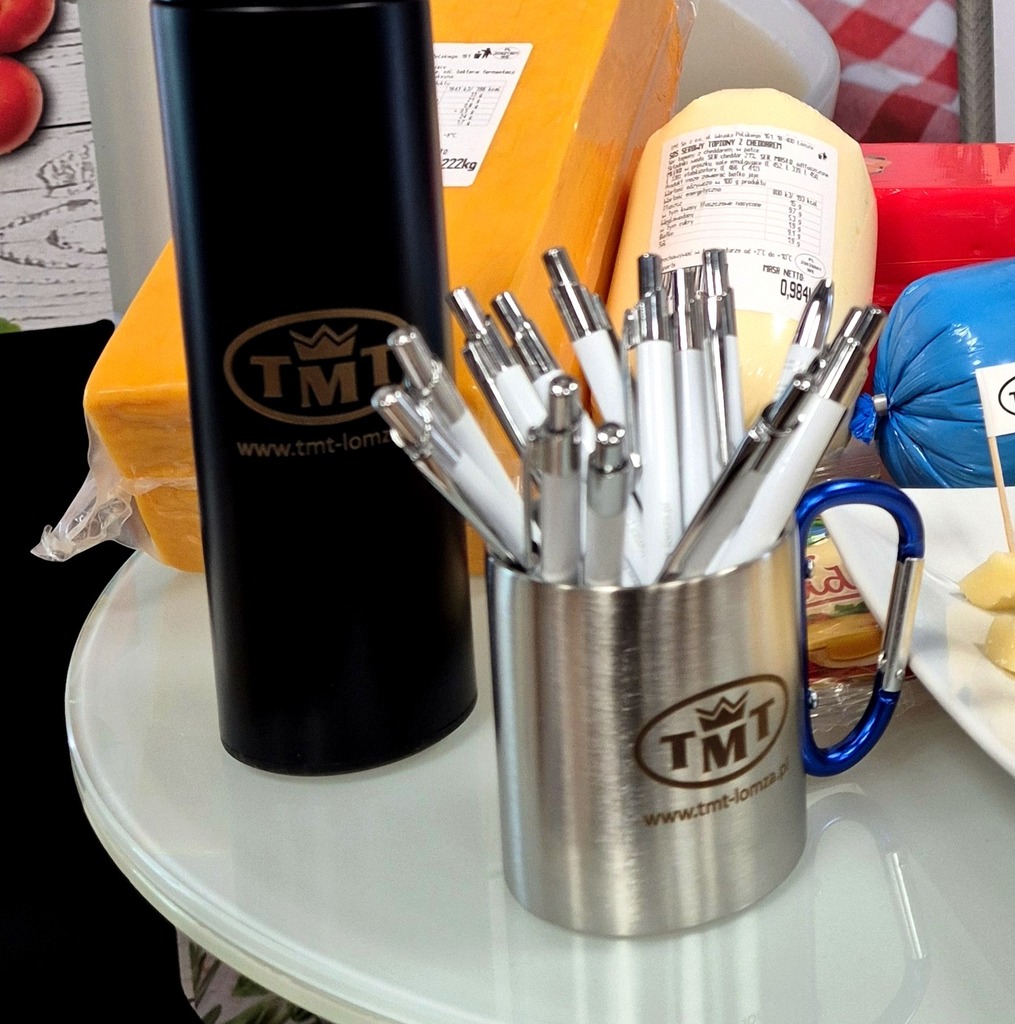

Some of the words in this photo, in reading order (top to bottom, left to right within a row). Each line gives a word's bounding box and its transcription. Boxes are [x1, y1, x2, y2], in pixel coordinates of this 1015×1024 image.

[681, 143, 705, 154] SEROWY
[708, 139, 735, 147] TOPIONY
[746, 139, 782, 150] CHEDDAREM
[442, 158, 477, 171] 222kg
[763, 265, 780, 274] MASA
[250, 344, 391, 408] TMT
[237, 431, 391, 457] www.tmt-lomz
[660, 698, 775, 773] TMT
[642, 756, 790, 826] www.tmt-lomza.pl
